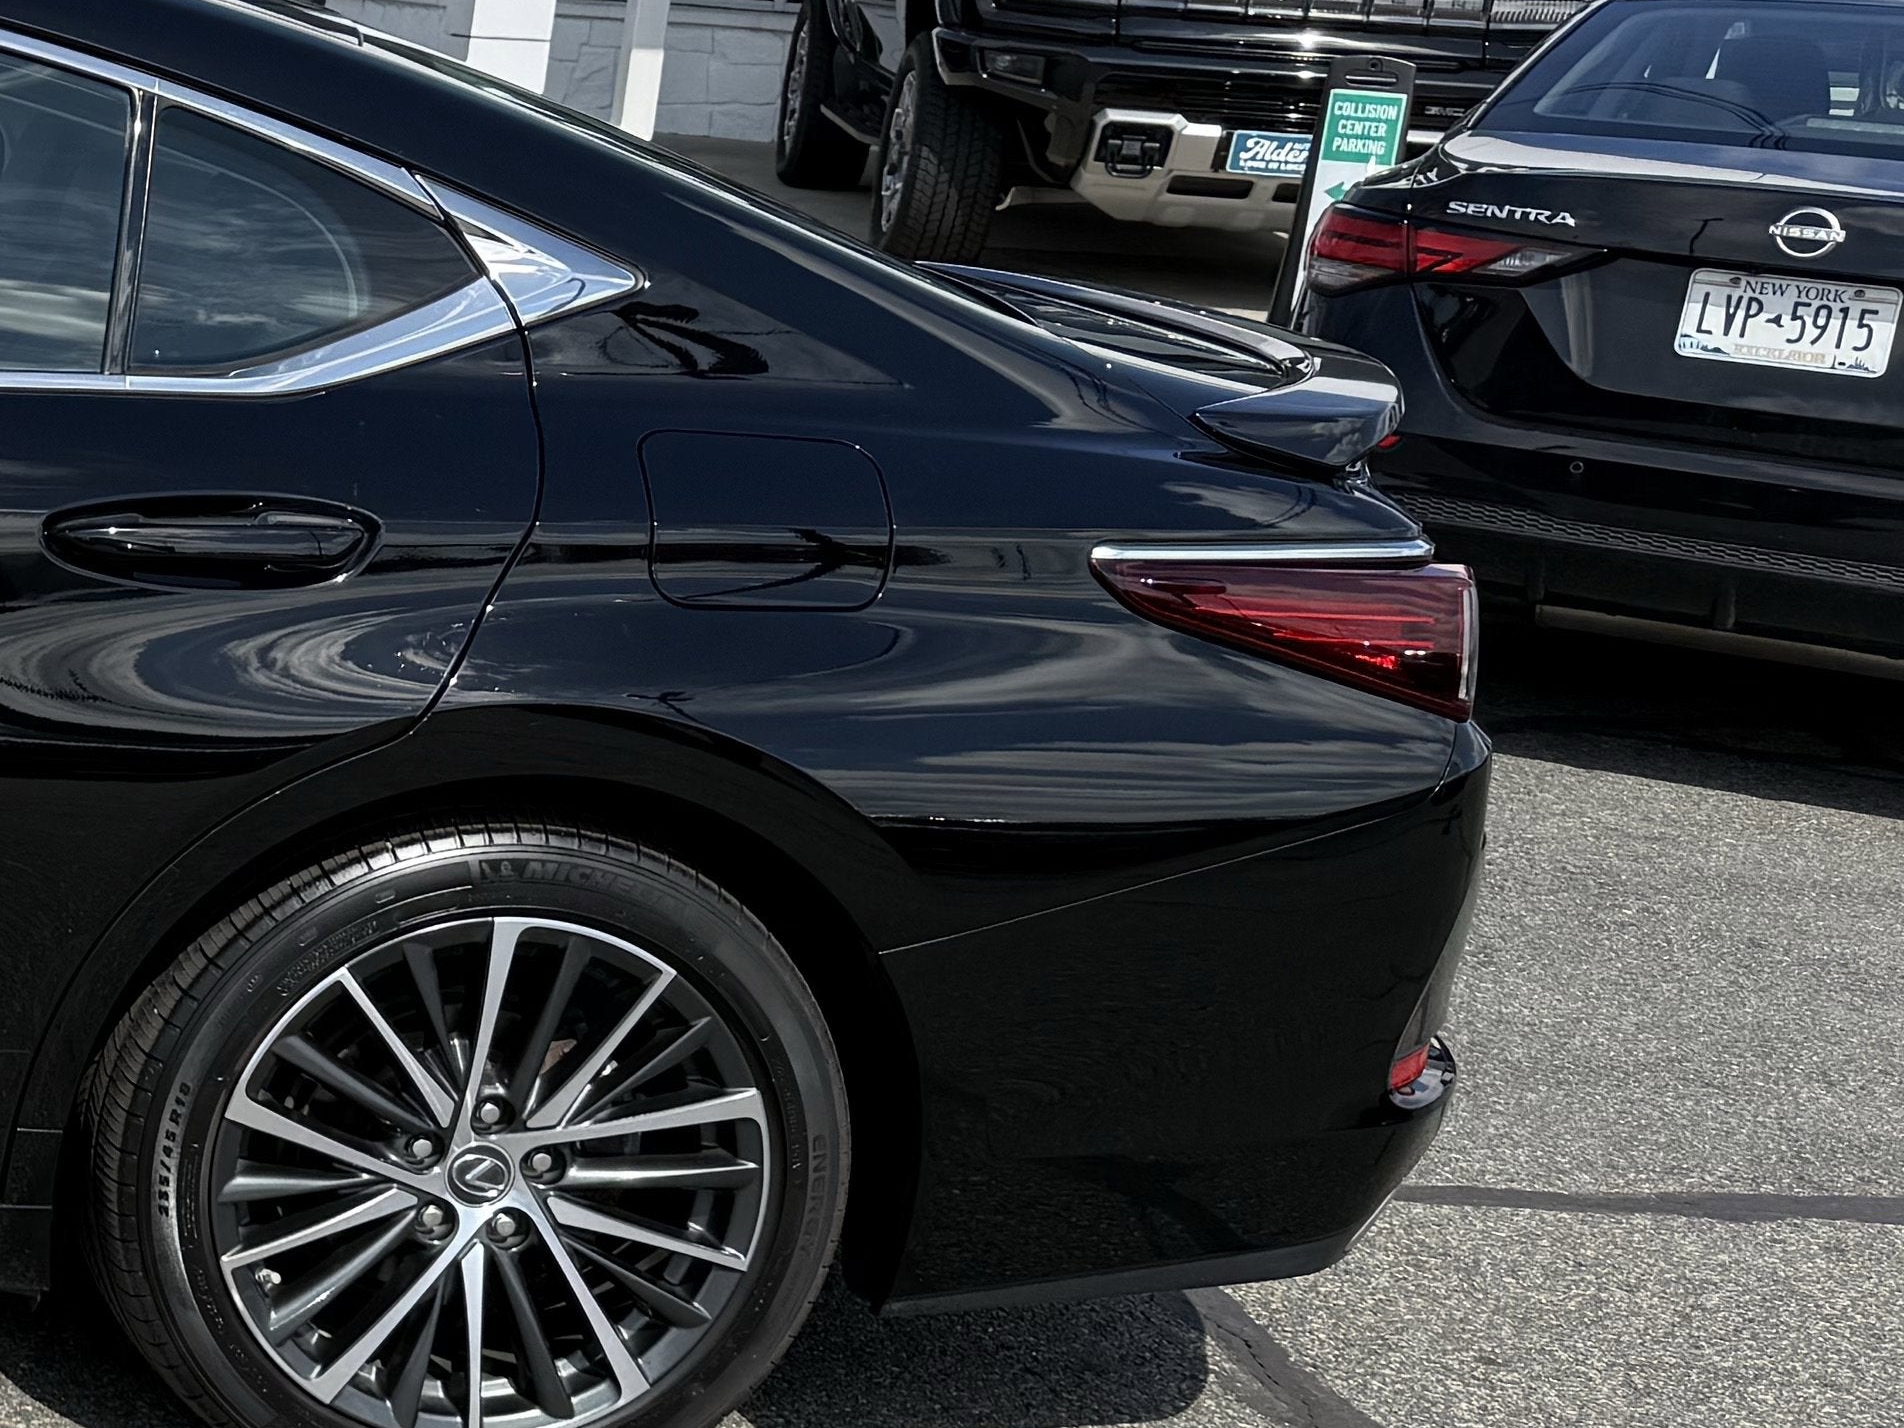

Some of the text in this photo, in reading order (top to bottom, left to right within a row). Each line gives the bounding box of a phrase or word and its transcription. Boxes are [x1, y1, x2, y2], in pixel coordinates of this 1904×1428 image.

[1334, 101, 1398, 120] COLLISION
[1337, 120, 1387, 137] CENTER
[1332, 136, 1386, 156] PARKING
[1446, 201, 1576, 228] SENTRA
[1768, 222, 1847, 243] NISSAN
[1742, 280, 1849, 304] NEW YORK
